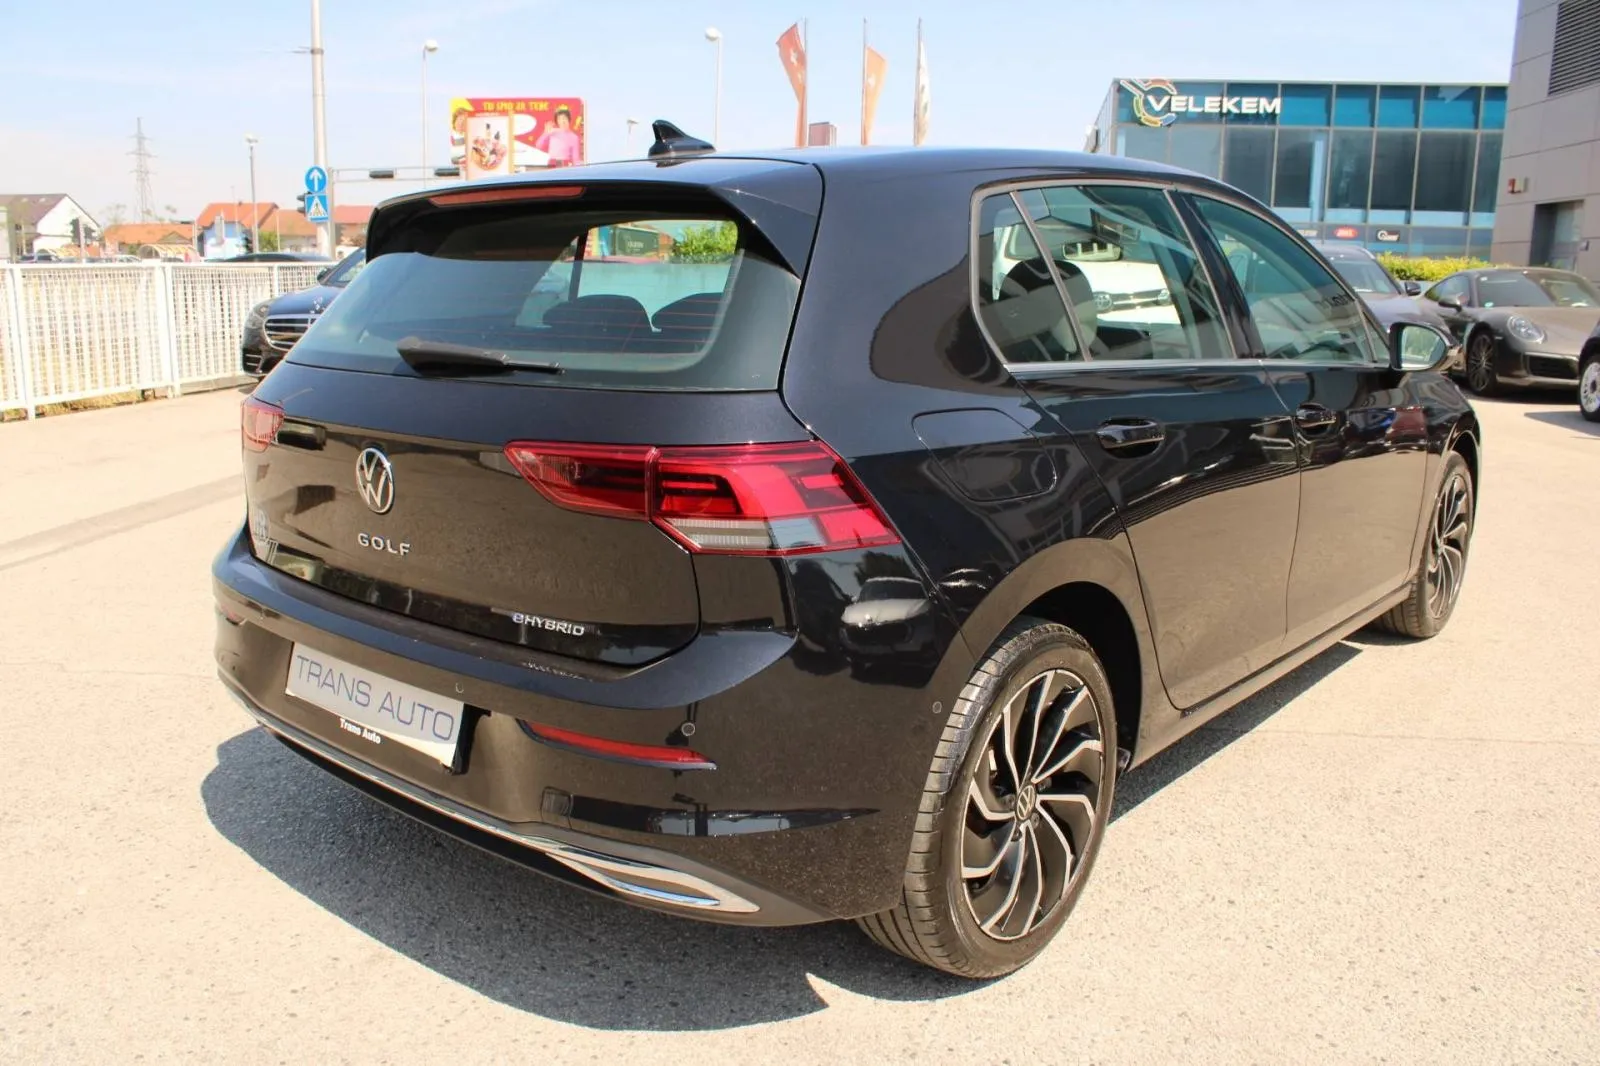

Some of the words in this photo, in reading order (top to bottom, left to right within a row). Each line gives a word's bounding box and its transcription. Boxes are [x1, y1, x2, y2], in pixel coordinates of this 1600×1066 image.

[1147, 95, 1281, 114] VELEKEM
[356, 447, 394, 513] VW
[357, 532, 411, 556] GOLF
[297, 655, 371, 707] TRANS
[378, 691, 454, 741] AUTO
[340, 717, 361, 736] Trans
[362, 728, 381, 744] Auto
